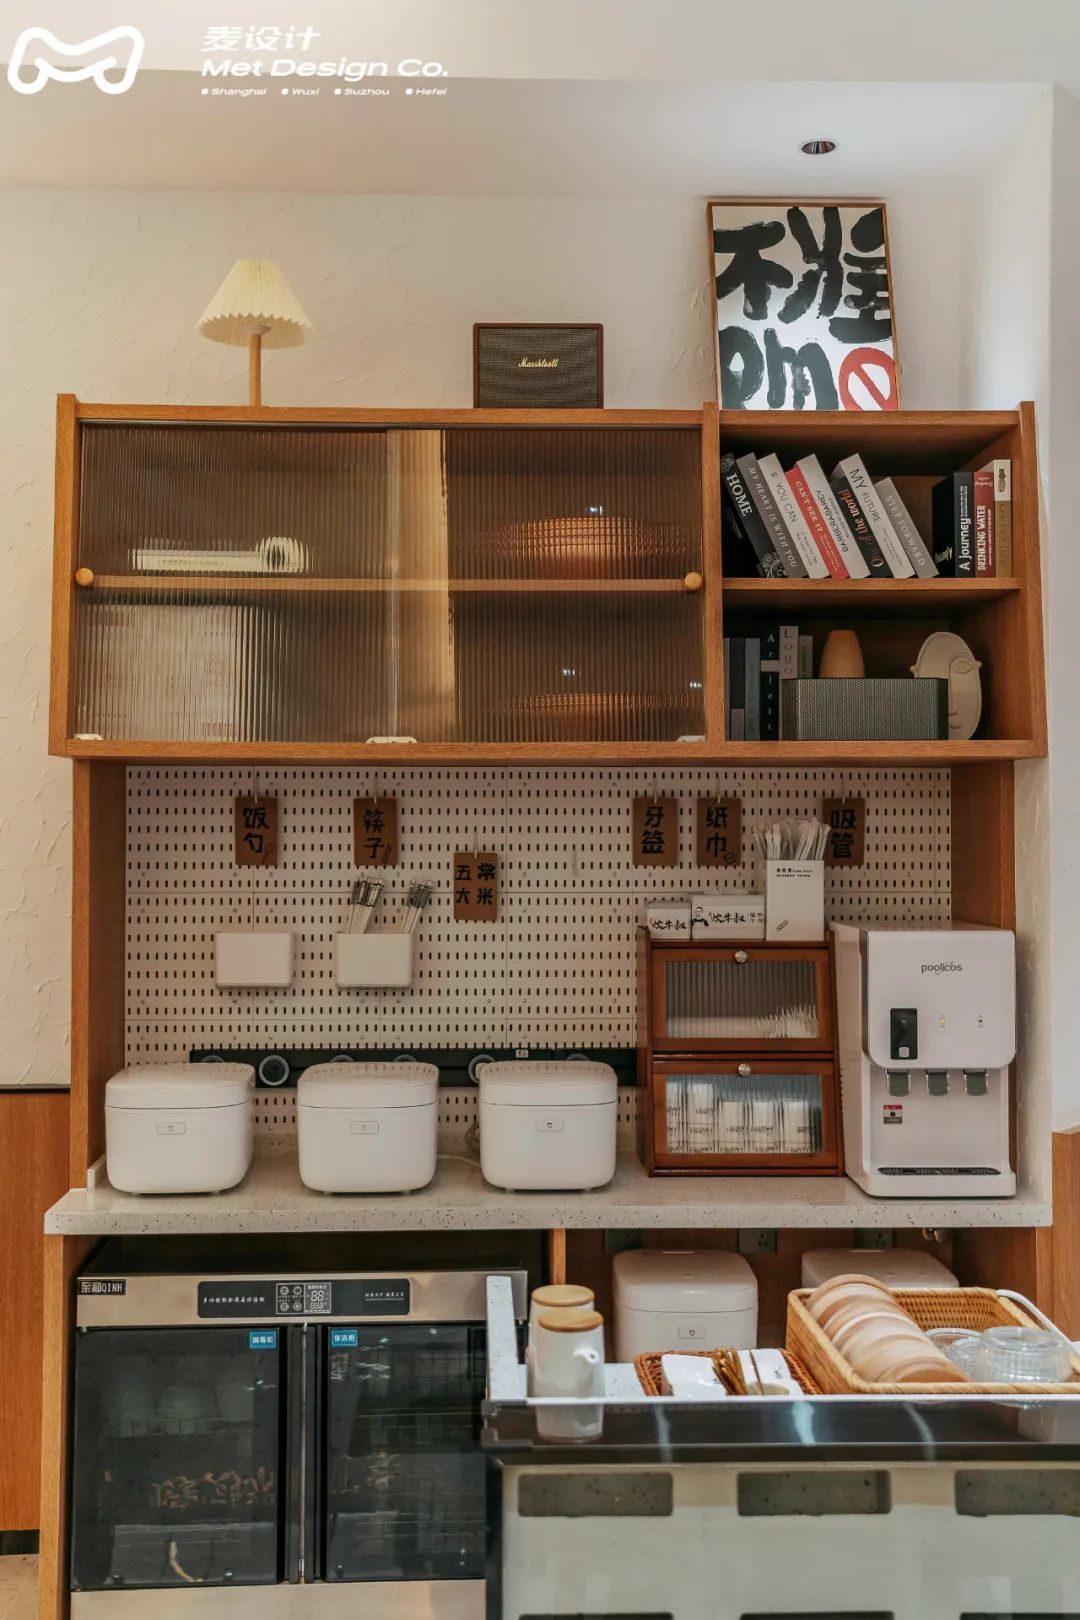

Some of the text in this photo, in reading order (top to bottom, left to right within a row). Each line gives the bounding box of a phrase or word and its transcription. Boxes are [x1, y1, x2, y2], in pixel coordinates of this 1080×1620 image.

[726, 473, 754, 517] HOME
[747, 466, 799, 569] MY HEART IS WITH YOU
[769, 471, 799, 524] IF YOU CAN
[794, 480, 811, 506] CAN'T
[806, 505, 819, 523] SEE
[840, 487, 860, 518] world
[848, 467, 882, 524] MY FUTURE
[853, 516, 869, 537] the
[885, 494, 902, 520] STEP
[898, 519, 926, 568] FORWARD
[959, 518, 973, 560] journey
[976, 504, 986, 571] DRINKING WATER
[959, 561, 970, 571] A
[242, 806, 269, 854] 饭勺
[363, 808, 386, 859] 筷子
[641, 806, 665, 855] 牙签
[706, 806, 729, 858] 纸巾
[830, 808, 857, 859] 吸管
